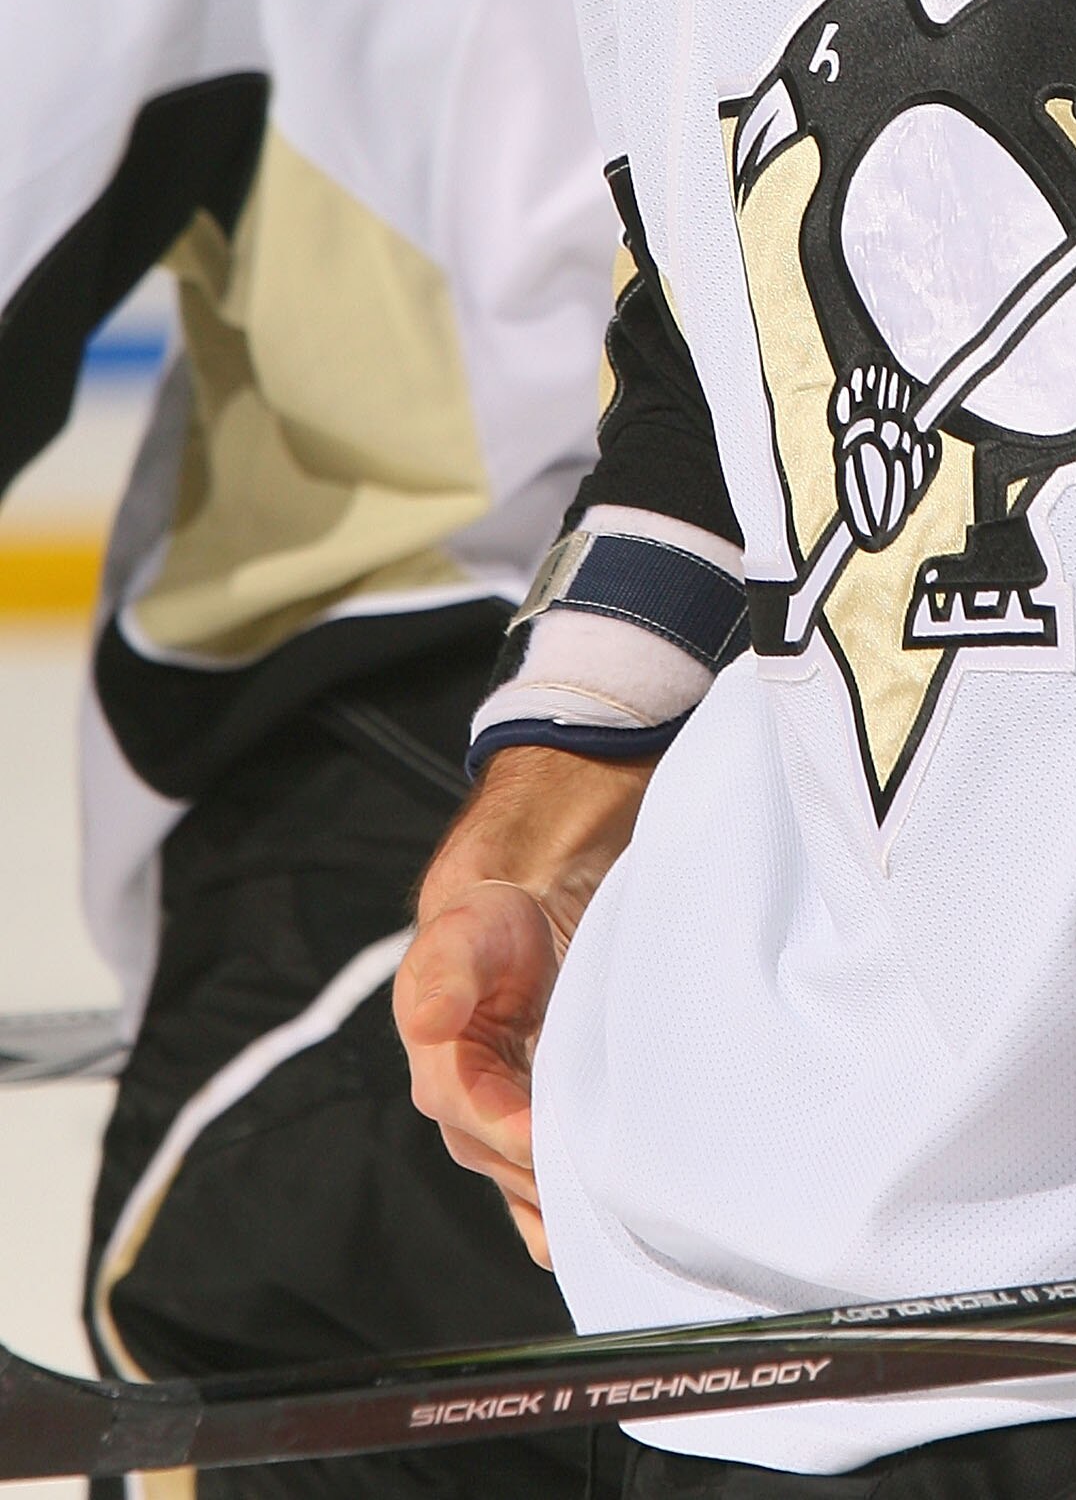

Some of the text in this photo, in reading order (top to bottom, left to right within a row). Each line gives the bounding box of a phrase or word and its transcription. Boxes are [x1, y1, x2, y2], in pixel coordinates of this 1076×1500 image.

[409, 1357, 832, 1428] SICKICK II TECHNOLOGY
